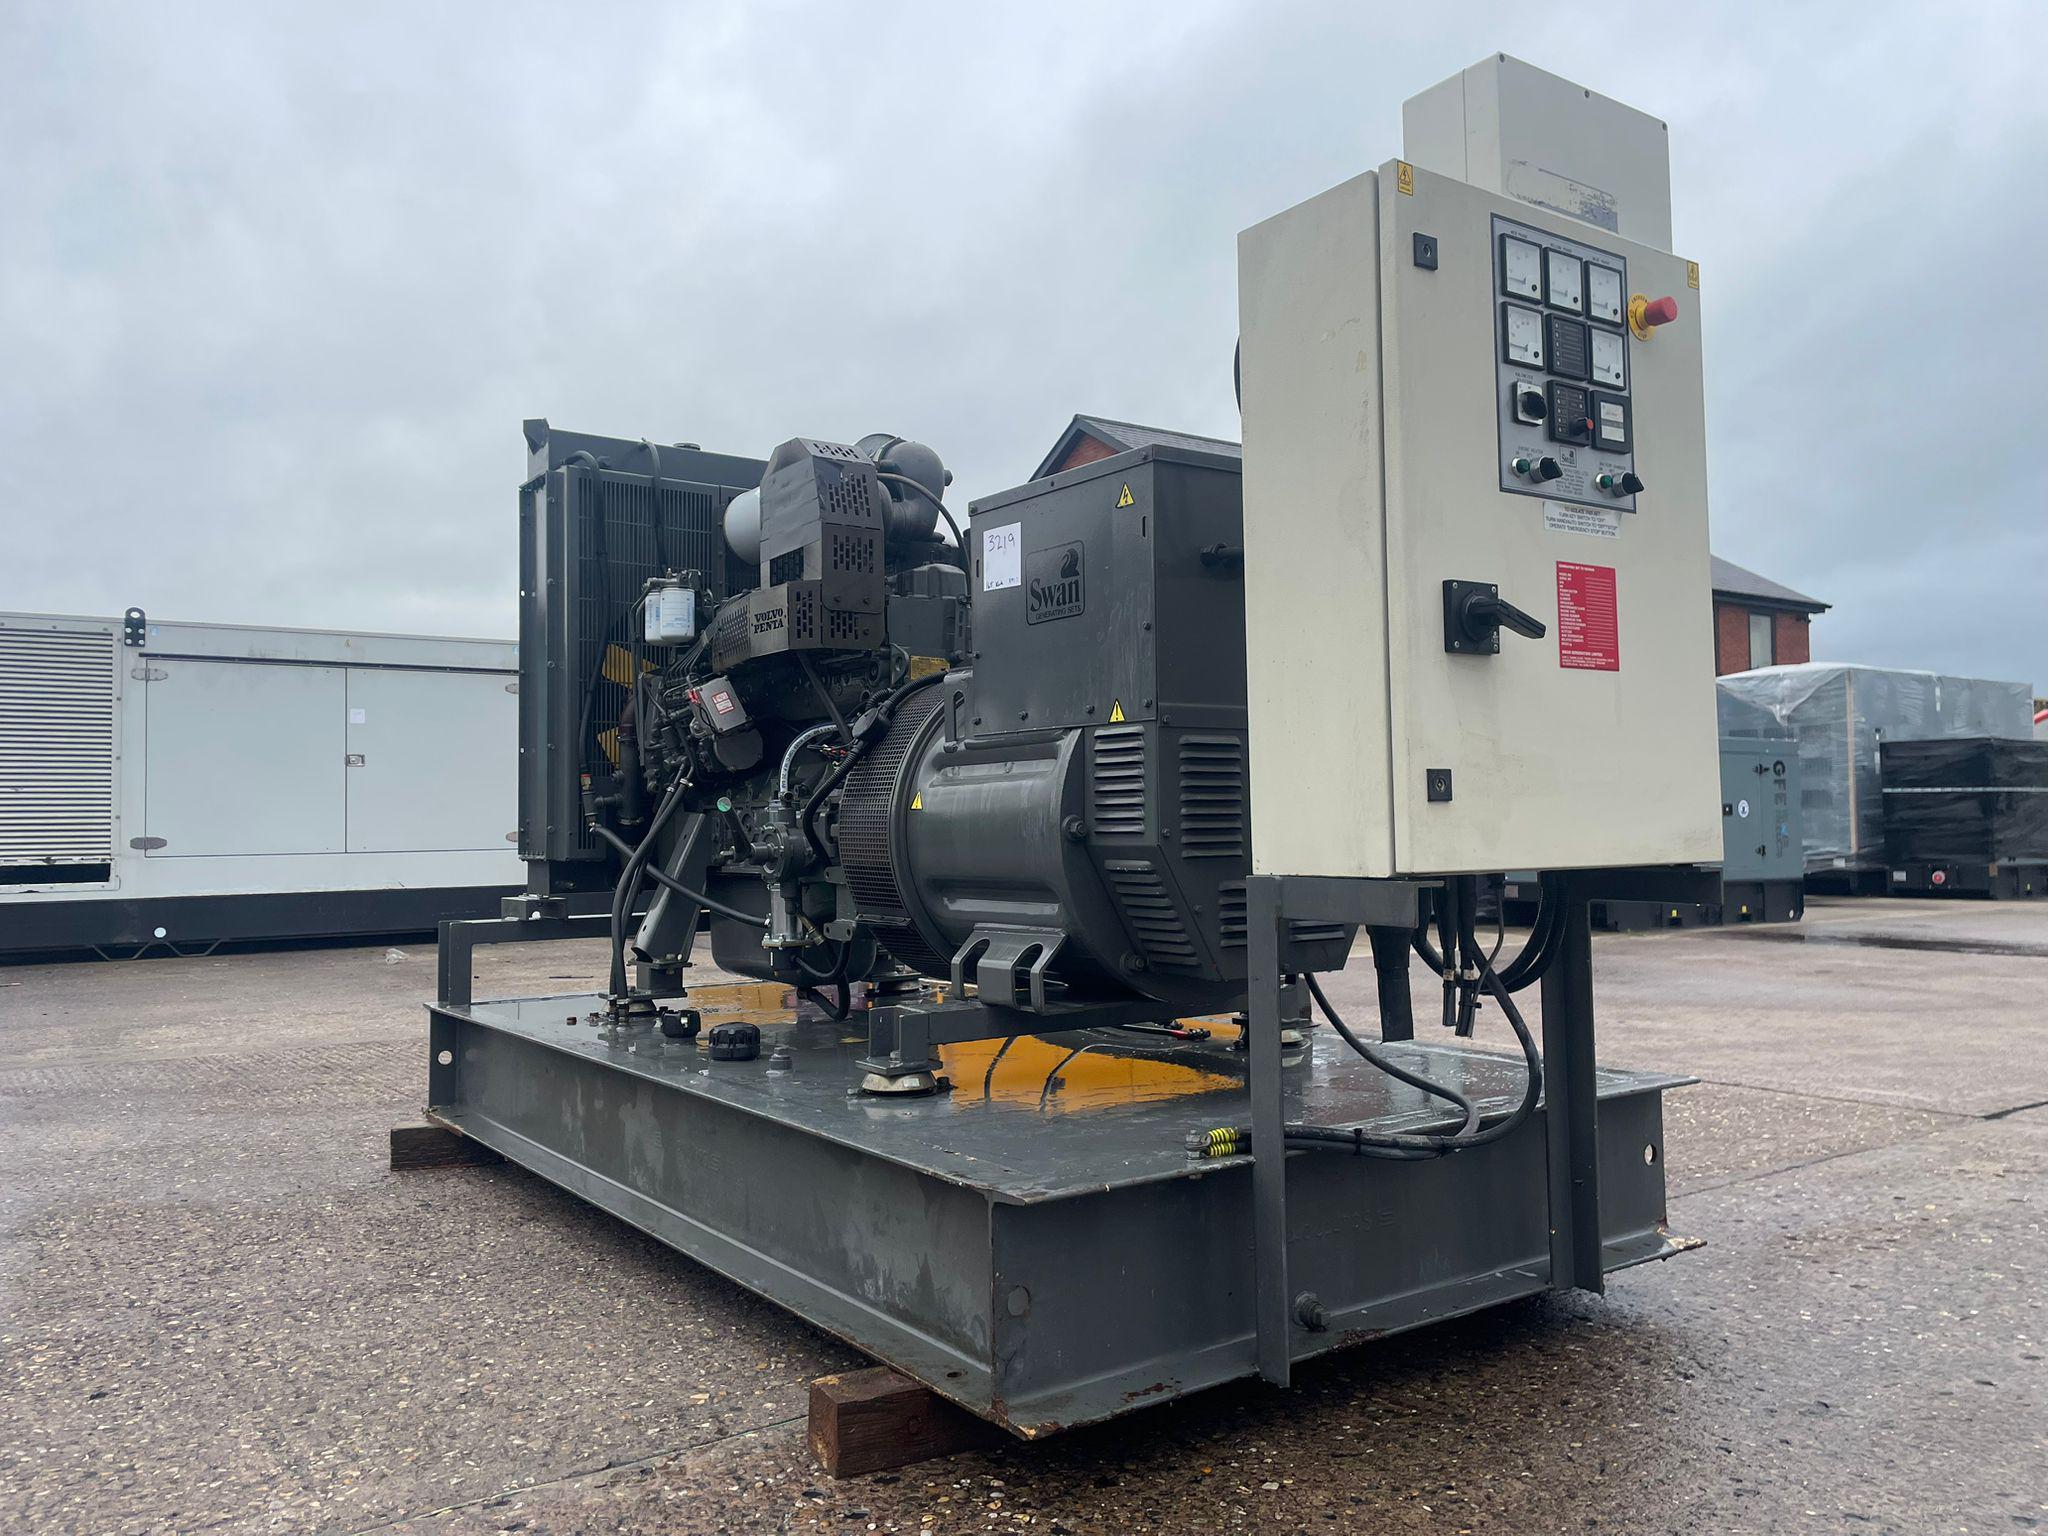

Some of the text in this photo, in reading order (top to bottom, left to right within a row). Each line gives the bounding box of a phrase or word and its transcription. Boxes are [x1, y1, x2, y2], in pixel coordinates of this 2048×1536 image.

[988, 533, 1016, 552] 3219
[1030, 578, 1080, 611] Swan
[754, 607, 784, 623] VOLVO
[1067, 604, 1082, 614] SETS
[754, 618, 784, 634] PENTA
